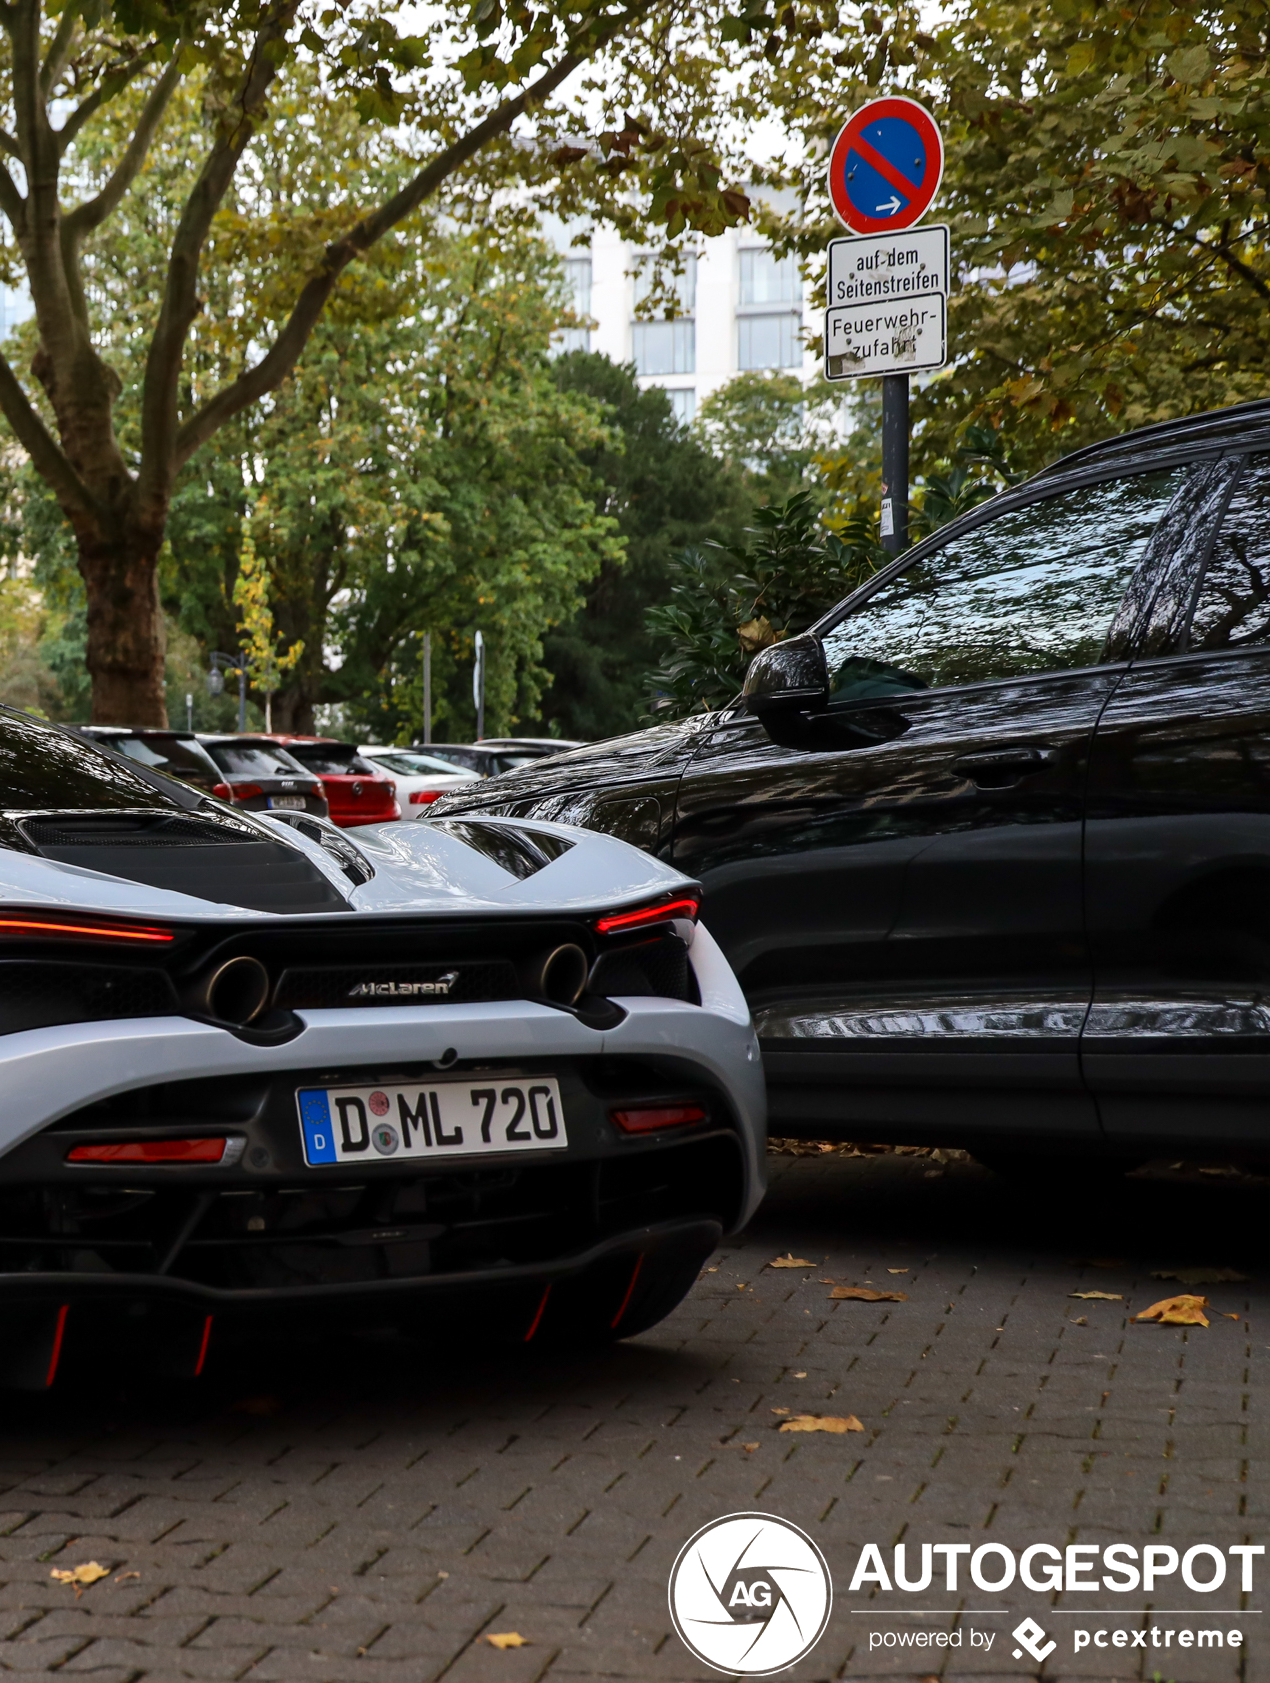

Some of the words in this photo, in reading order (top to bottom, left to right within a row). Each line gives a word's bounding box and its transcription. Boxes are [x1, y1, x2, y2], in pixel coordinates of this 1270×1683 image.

[856, 249, 880, 271] auf
[887, 247, 918, 268] dem
[837, 270, 939, 300] Seitenstreifen
[833, 308, 937, 337] Feuerwehr-
[349, 982, 448, 995] McLaren
[335, 1096, 370, 1152] D
[397, 1091, 463, 1148] ML
[470, 1085, 558, 1143] 720
